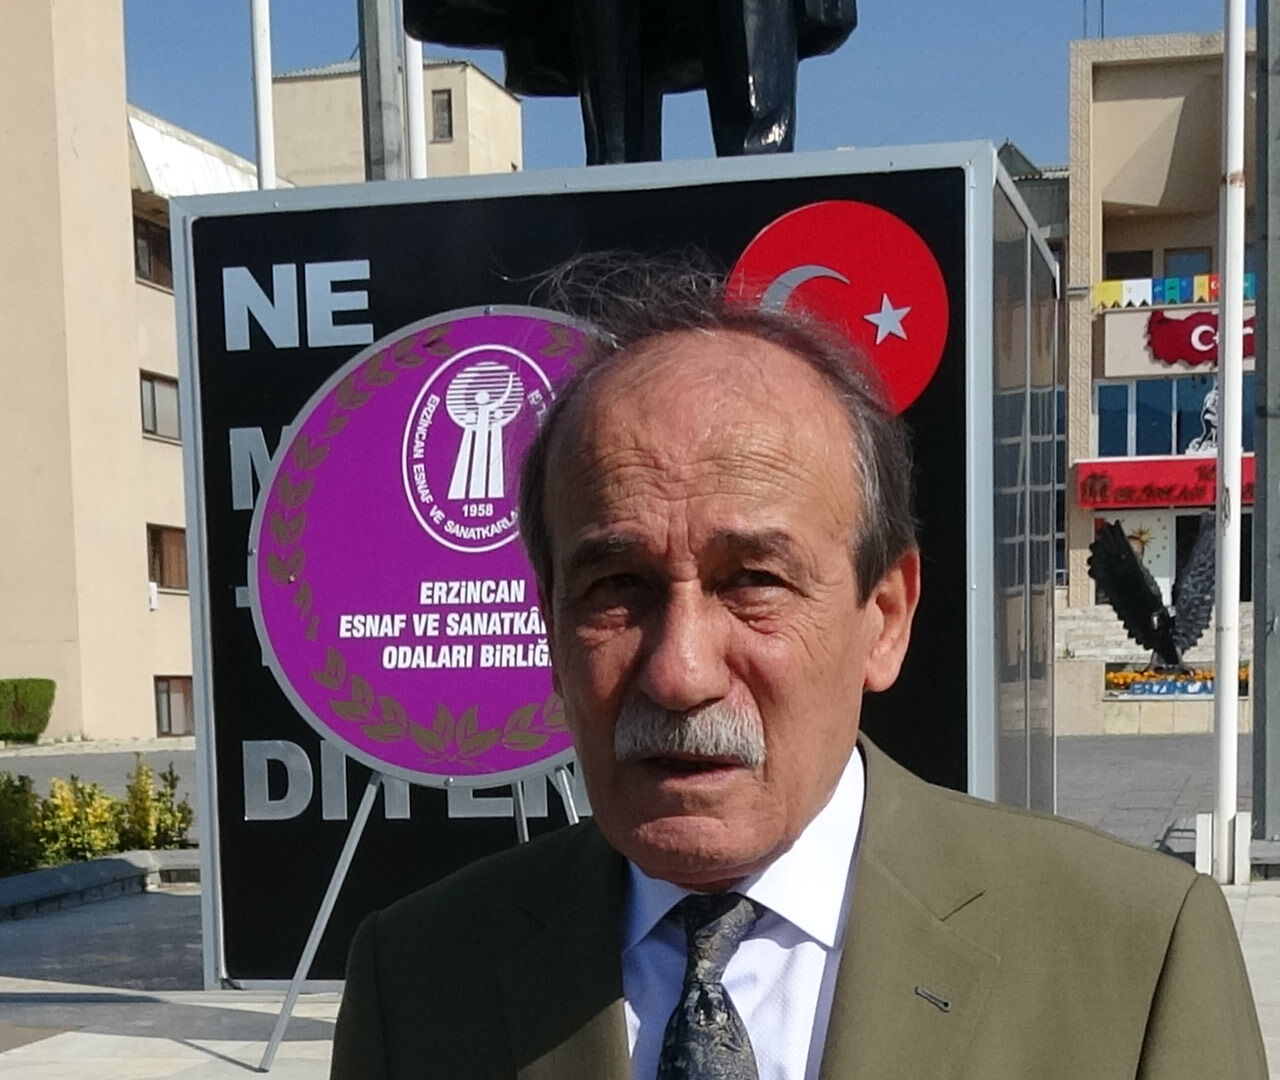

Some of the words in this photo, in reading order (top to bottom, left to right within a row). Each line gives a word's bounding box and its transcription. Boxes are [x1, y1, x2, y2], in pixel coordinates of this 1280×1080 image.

[222, 259, 374, 351] NE
[413, 463, 434, 504] ESNAF
[428, 504, 445, 524] VE
[444, 508, 519, 540] SANATKARLA
[462, 503, 494, 518] 1958
[339, 614, 406, 638] ESNAF
[413, 613, 440, 637] VE
[382, 645, 473, 669] ODALARI
[480, 638, 553, 668] BİRLİĞ
